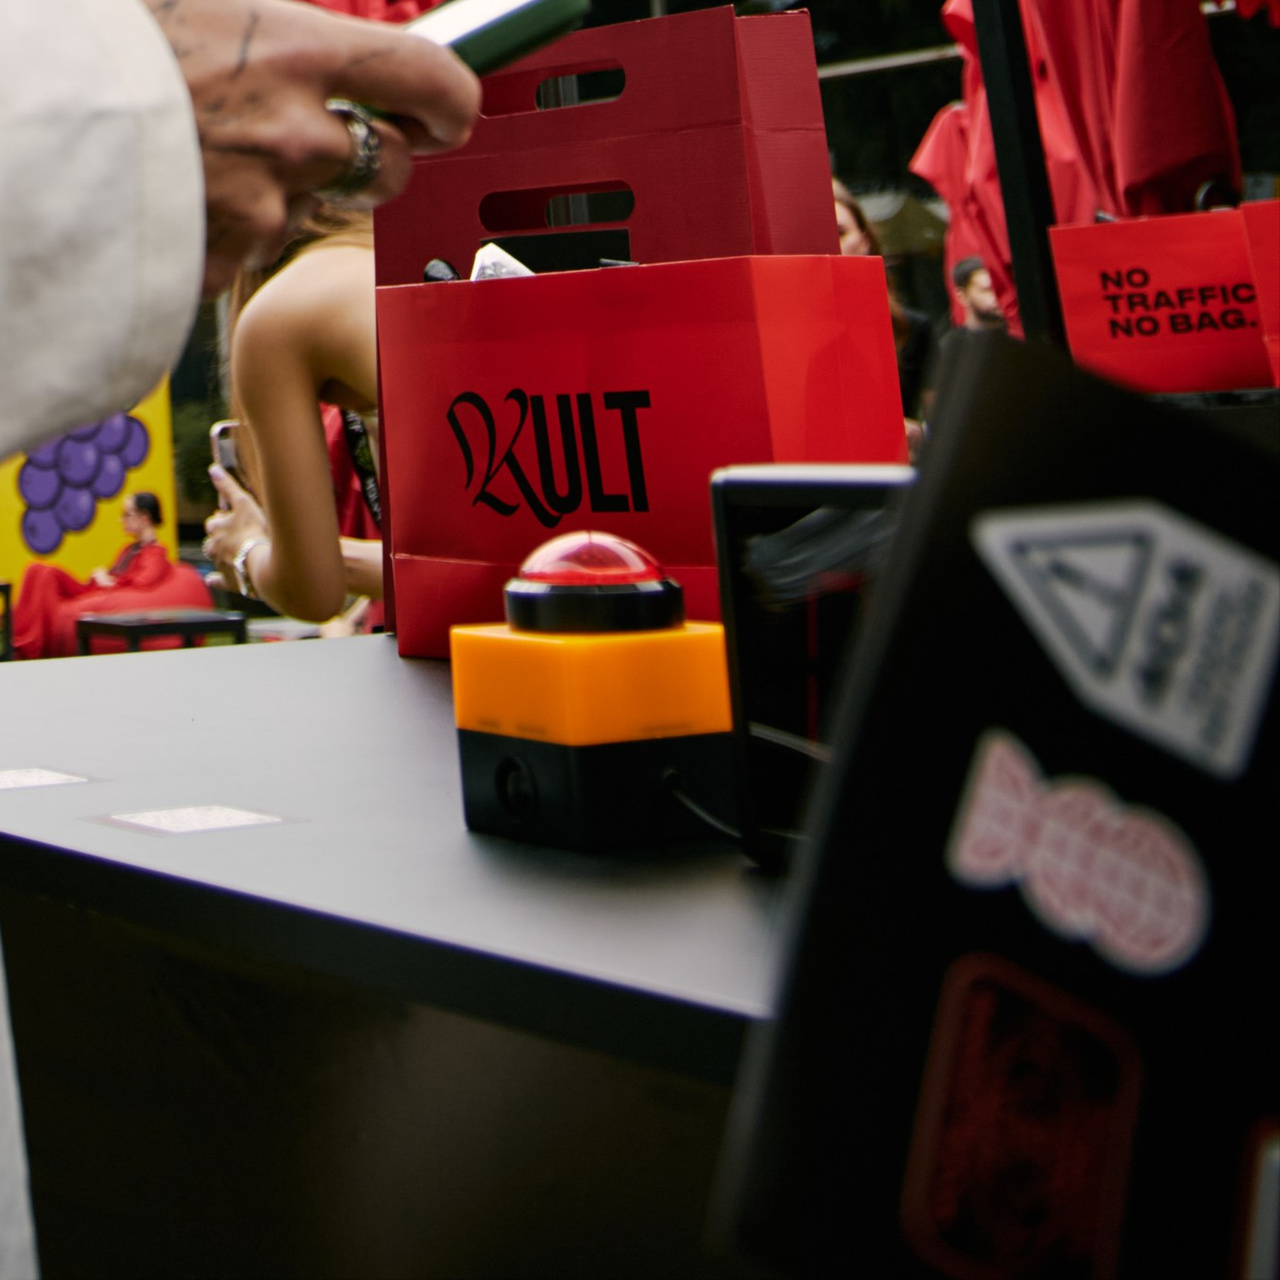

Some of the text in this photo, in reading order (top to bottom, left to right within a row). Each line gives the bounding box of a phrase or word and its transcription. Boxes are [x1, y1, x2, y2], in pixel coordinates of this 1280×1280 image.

[1100, 268, 1150, 290] NO
[1104, 283, 1257, 313] TRAFFIC
[1109, 309, 1258, 338] NO BAG.
[446, 388, 651, 528] KULT
